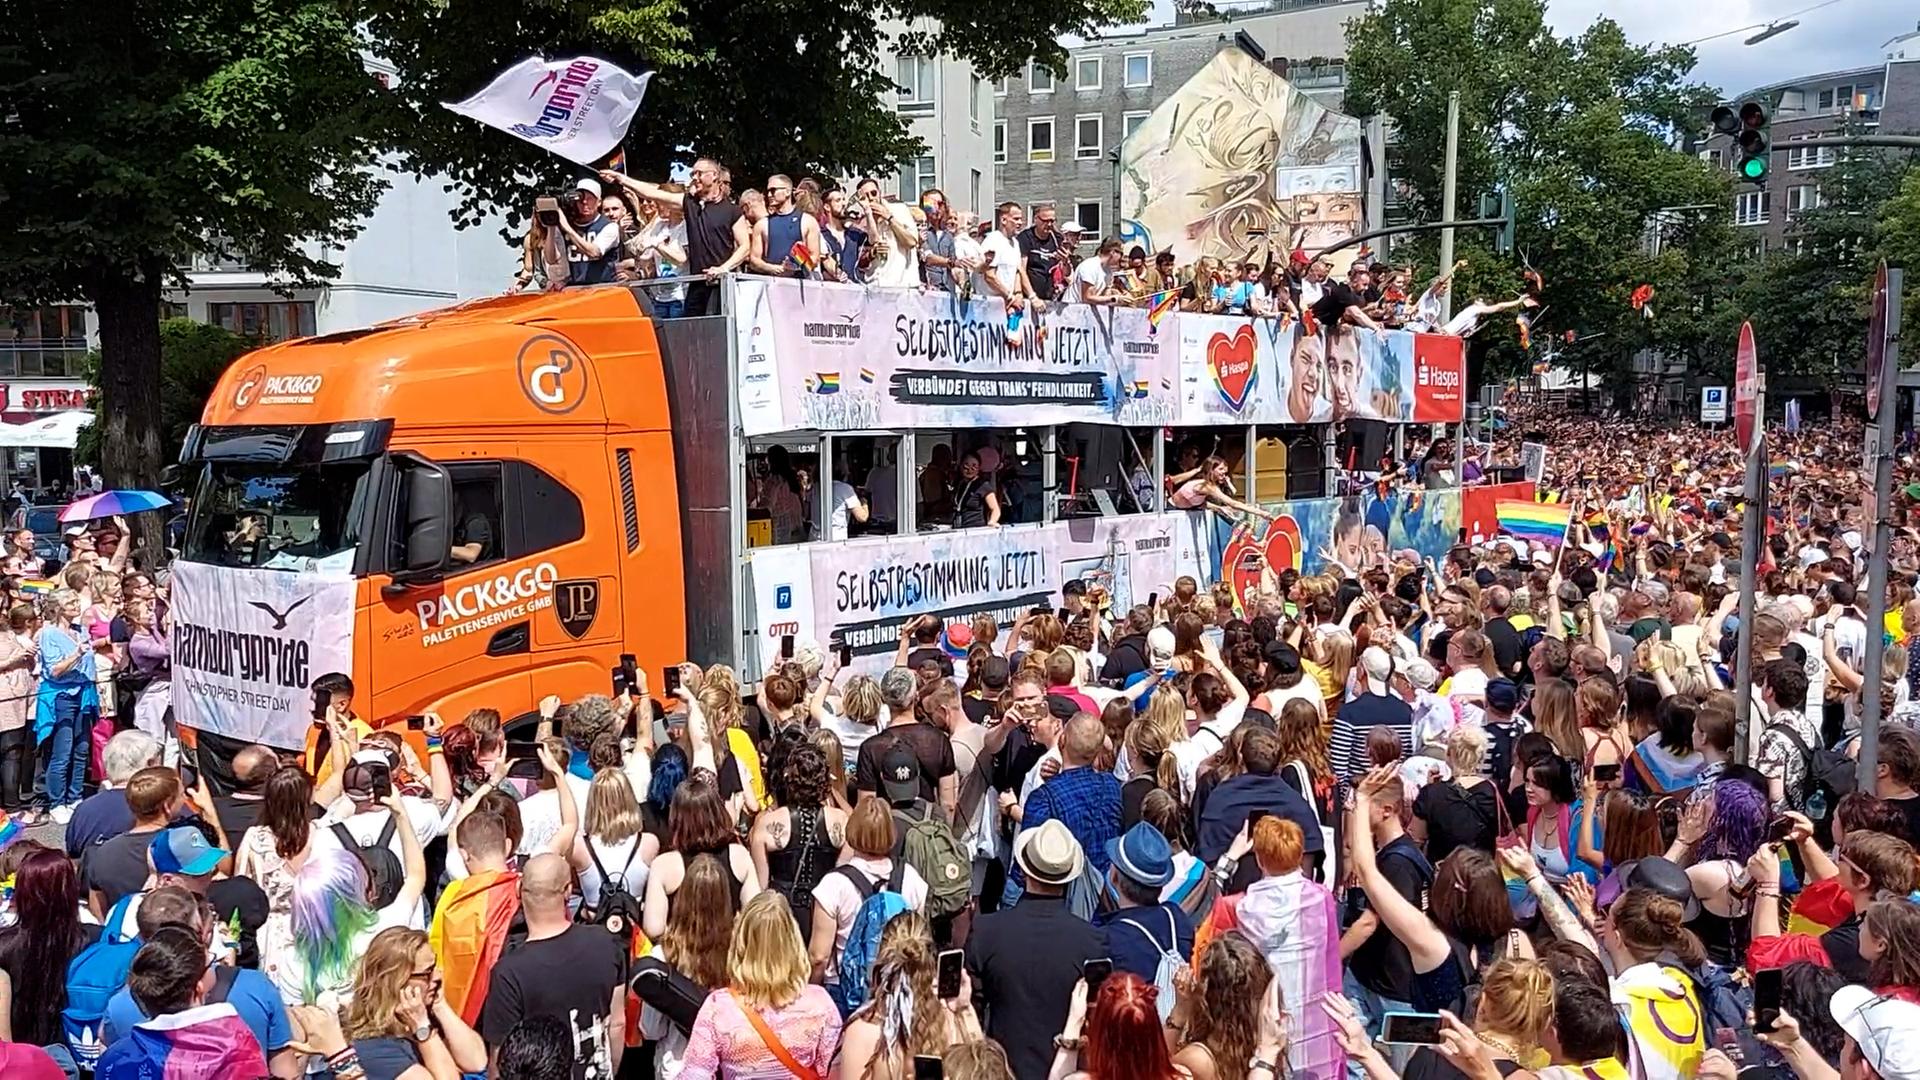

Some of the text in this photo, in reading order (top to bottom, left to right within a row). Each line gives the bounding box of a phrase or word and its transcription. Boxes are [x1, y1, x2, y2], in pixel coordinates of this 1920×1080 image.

[1228, 361, 1249, 376] Haspa
[1430, 366, 1459, 391] Haspa
[264, 375, 322, 394] PACK&GO
[907, 376, 967, 396] VERBÜNDET
[969, 380, 998, 397] GEGEN
[416, 562, 558, 631] PACK&GO
[836, 556, 990, 613] SELBSTBESTIMMUNG
[563, 584, 596, 623] JP
[422, 596, 553, 648] PALETTENSERVICE GMB
[769, 621, 799, 637] OTTO
[844, 624, 904, 648] VERBÜNDE
[174, 620, 309, 689] hamburgpride
[241, 690, 271, 708] STREET
[272, 698, 291, 713] DAY
